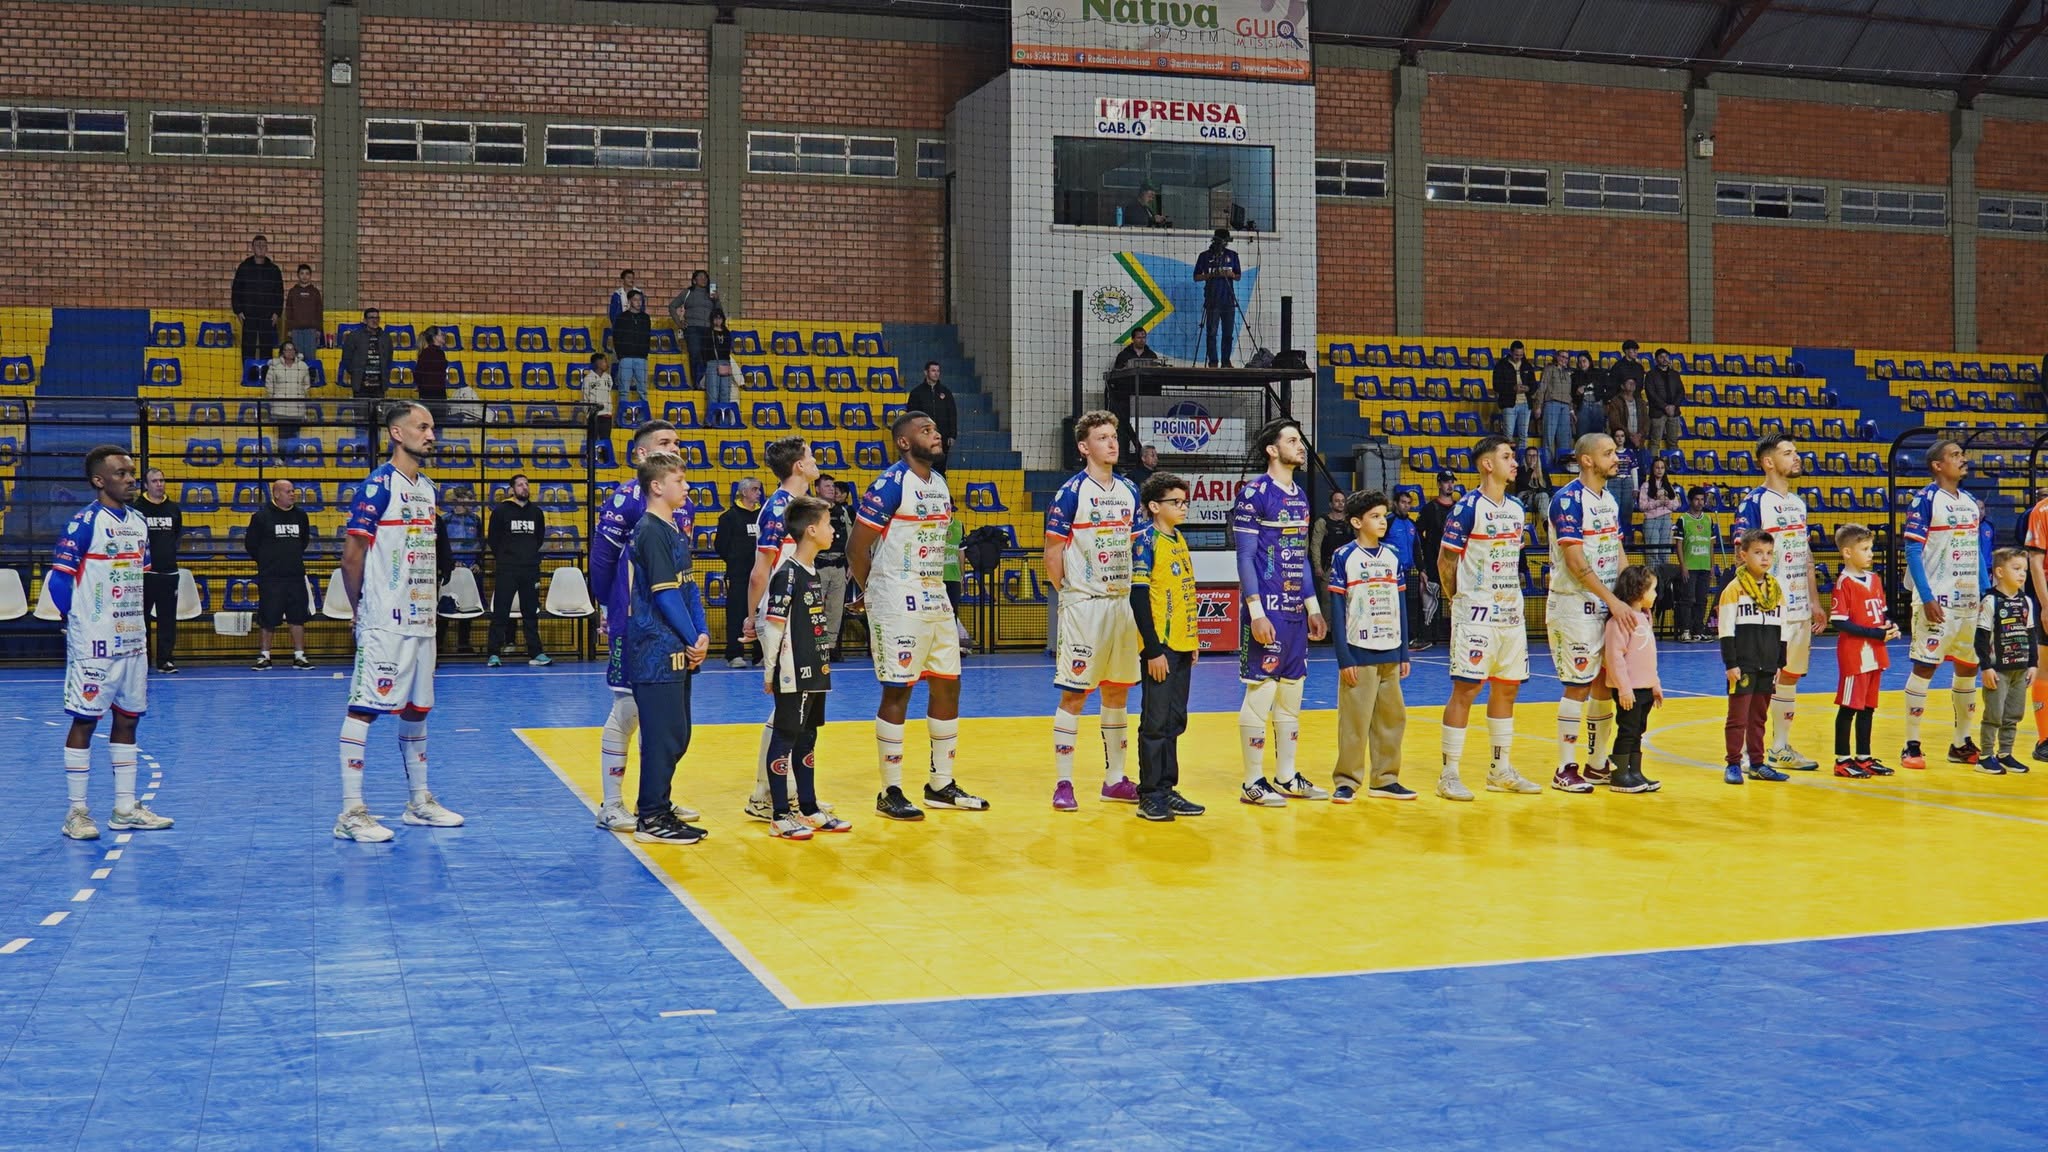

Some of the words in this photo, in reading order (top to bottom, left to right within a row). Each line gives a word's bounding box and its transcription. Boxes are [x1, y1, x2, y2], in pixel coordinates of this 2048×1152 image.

[1082, 0, 1219, 29] Nativa
[1153, 26, 1188, 41] 87.9
[1100, 98, 1242, 124] IMPRENSA
[1098, 121, 1130, 134] CAB.
[1200, 126, 1230, 139] CAB.
[906, 595, 916, 611] 9
[1266, 594, 1279, 611] 12
[1937, 595, 1948, 607] 15
[393, 609, 402, 625] 4
[1471, 606, 1488, 621] 77
[1359, 629, 1368, 640] 10
[92, 640, 107, 657] 18
[874, 624, 885, 664] Sicredi
[1241, 624, 1250, 663] Sicredi
[670, 652, 685, 671] 10
[2002, 656, 2009, 665] 15
[800, 666, 812, 679] 20
